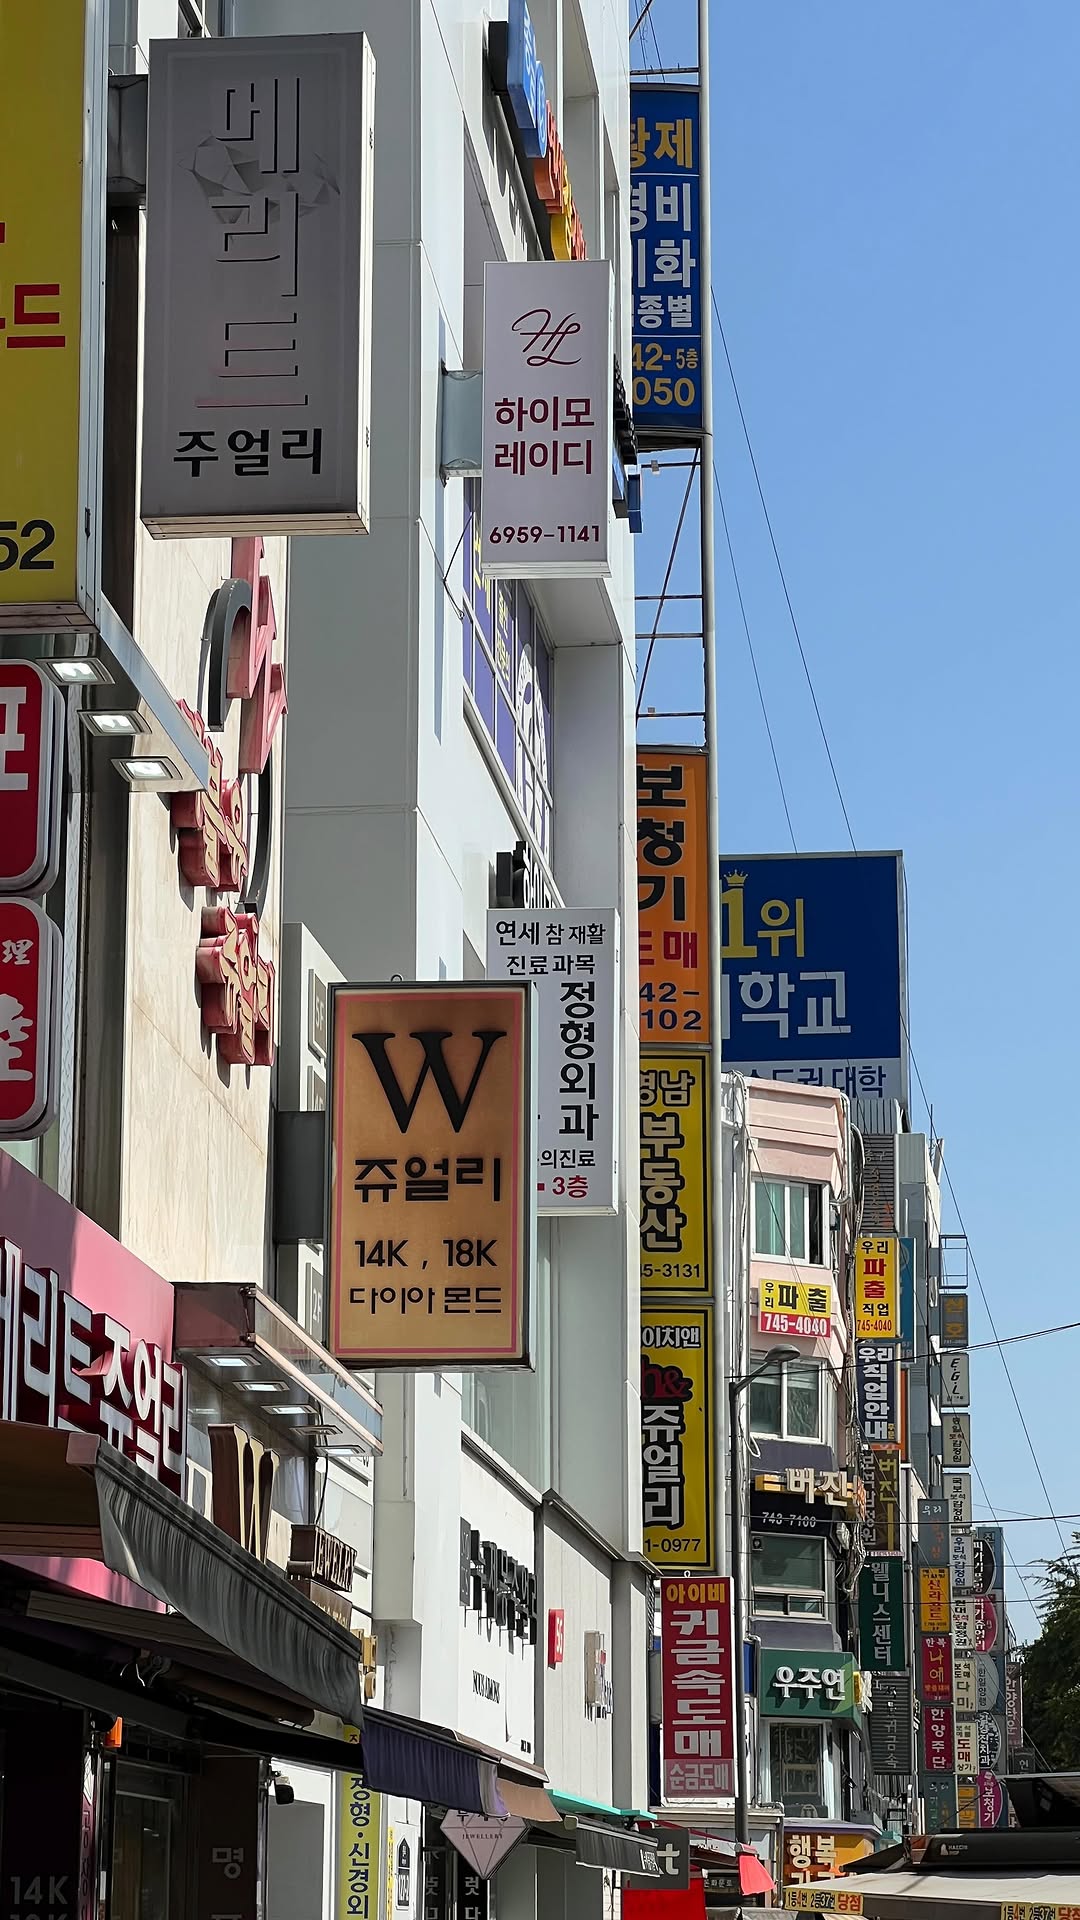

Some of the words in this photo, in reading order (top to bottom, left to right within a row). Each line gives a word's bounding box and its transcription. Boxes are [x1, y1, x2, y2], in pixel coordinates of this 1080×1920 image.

[631, 294, 693, 329] 종별
[494, 396, 594, 432] 하이모
[173, 427, 324, 478] 주얼리
[494, 440, 592, 475] 레이디
[489, 525, 600, 544] 6959-1141
[496, 920, 540, 946] 연세
[558, 981, 600, 1141] 정형외과
[352, 1031, 507, 1134] W
[537, 1149, 596, 1169] 의진료
[354, 1157, 501, 1203] 쥬얼리
[640, 1112, 688, 1252] 부동산
[354, 1239, 408, 1268] 14K
[442, 1238, 498, 1267] 18K
[861, 1240, 889, 1255] 우리
[640, 1263, 701, 1278] 5-3131
[863, 1258, 887, 1299] 파출
[778, 1284, 827, 1313] 파출
[862, 1303, 889, 1317] 직업
[0, 1236, 93, 1429] 리트
[764, 1314, 827, 1336] 745-4040
[857, 1319, 892, 1332] 745-4040
[858, 1347, 893, 1363] 우리
[642, 1404, 683, 1526] 쥬얼리
[785, 1467, 848, 1507] 버진
[666, 1583, 726, 1604] 아이비
[871, 1561, 892, 1667] 웰니스센터
[670, 1609, 727, 1757] 귀금속도매
[773, 1666, 846, 1701] 우주연
[931, 1708, 947, 1770] 한양주단
[957, 1738, 971, 1762] 도매
[669, 1763, 729, 1791] 순금도매
[789, 1835, 837, 1869] 행복
[9, 1876, 69, 1905] 14K
